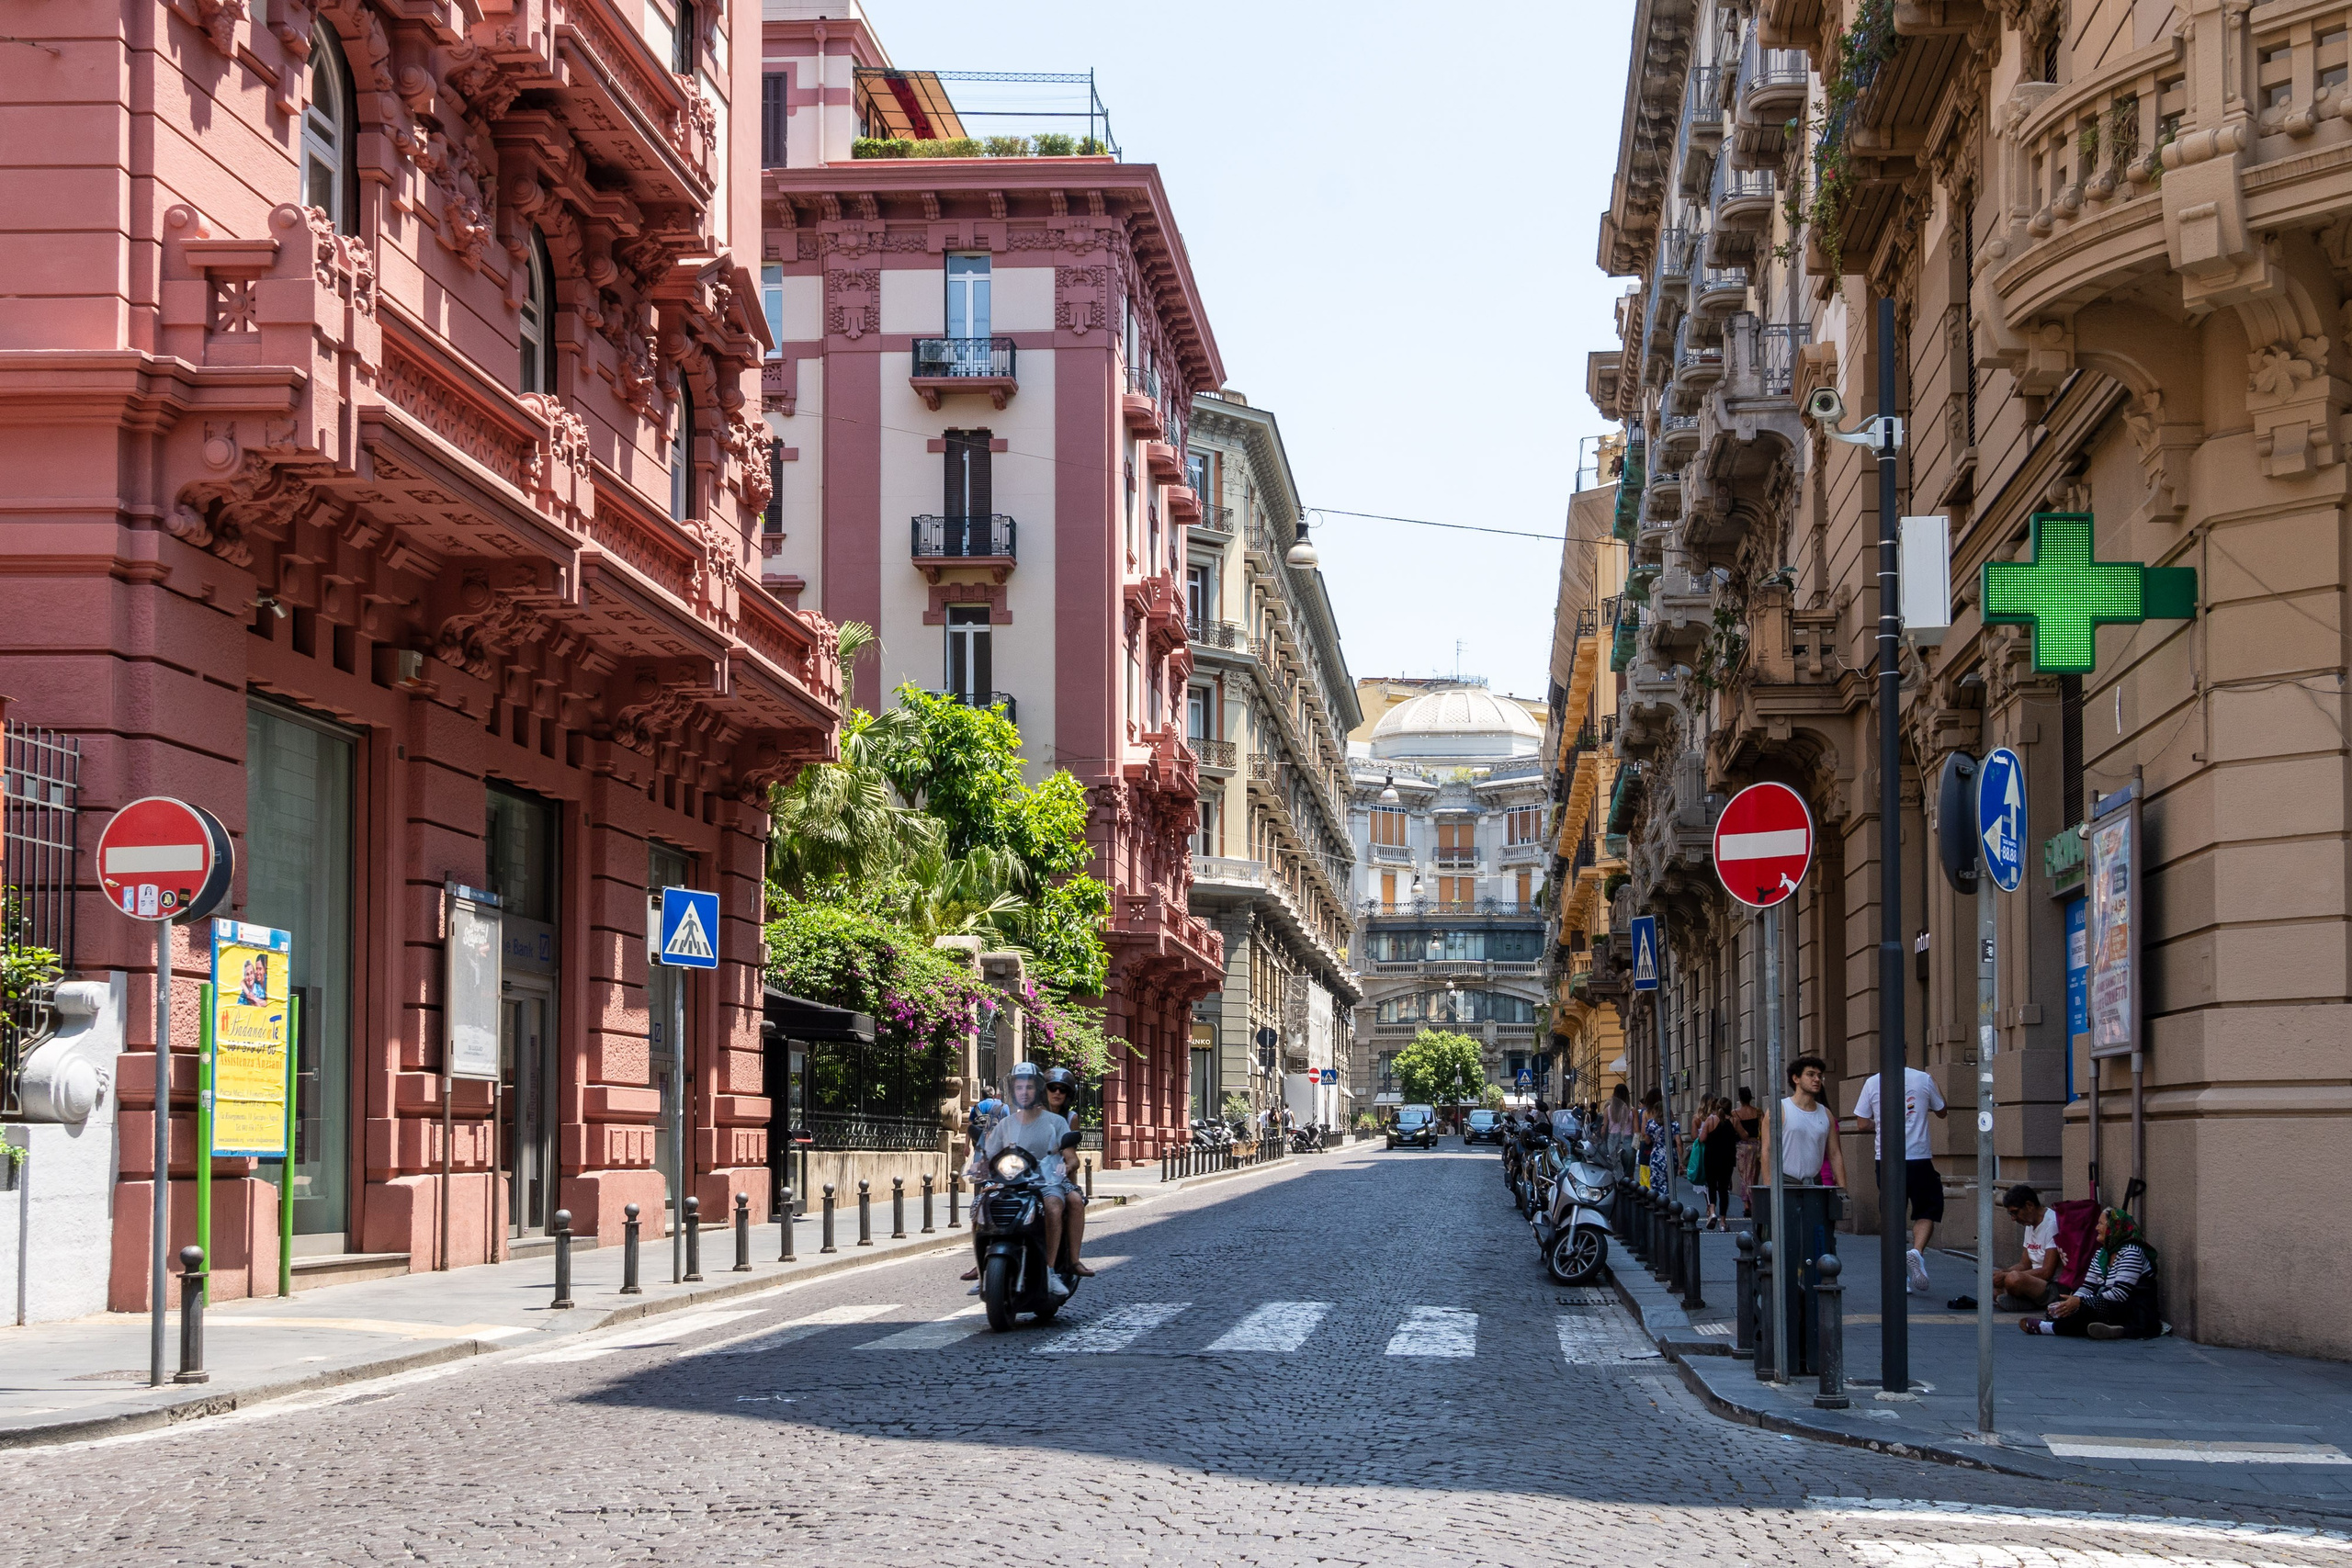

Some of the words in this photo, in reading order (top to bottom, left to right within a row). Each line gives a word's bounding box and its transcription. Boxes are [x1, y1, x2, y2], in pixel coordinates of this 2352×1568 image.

[514, 938, 534, 959] Bank
[219, 1054, 254, 1068] Assistenza
[255, 1056, 283, 1070] Anziani
